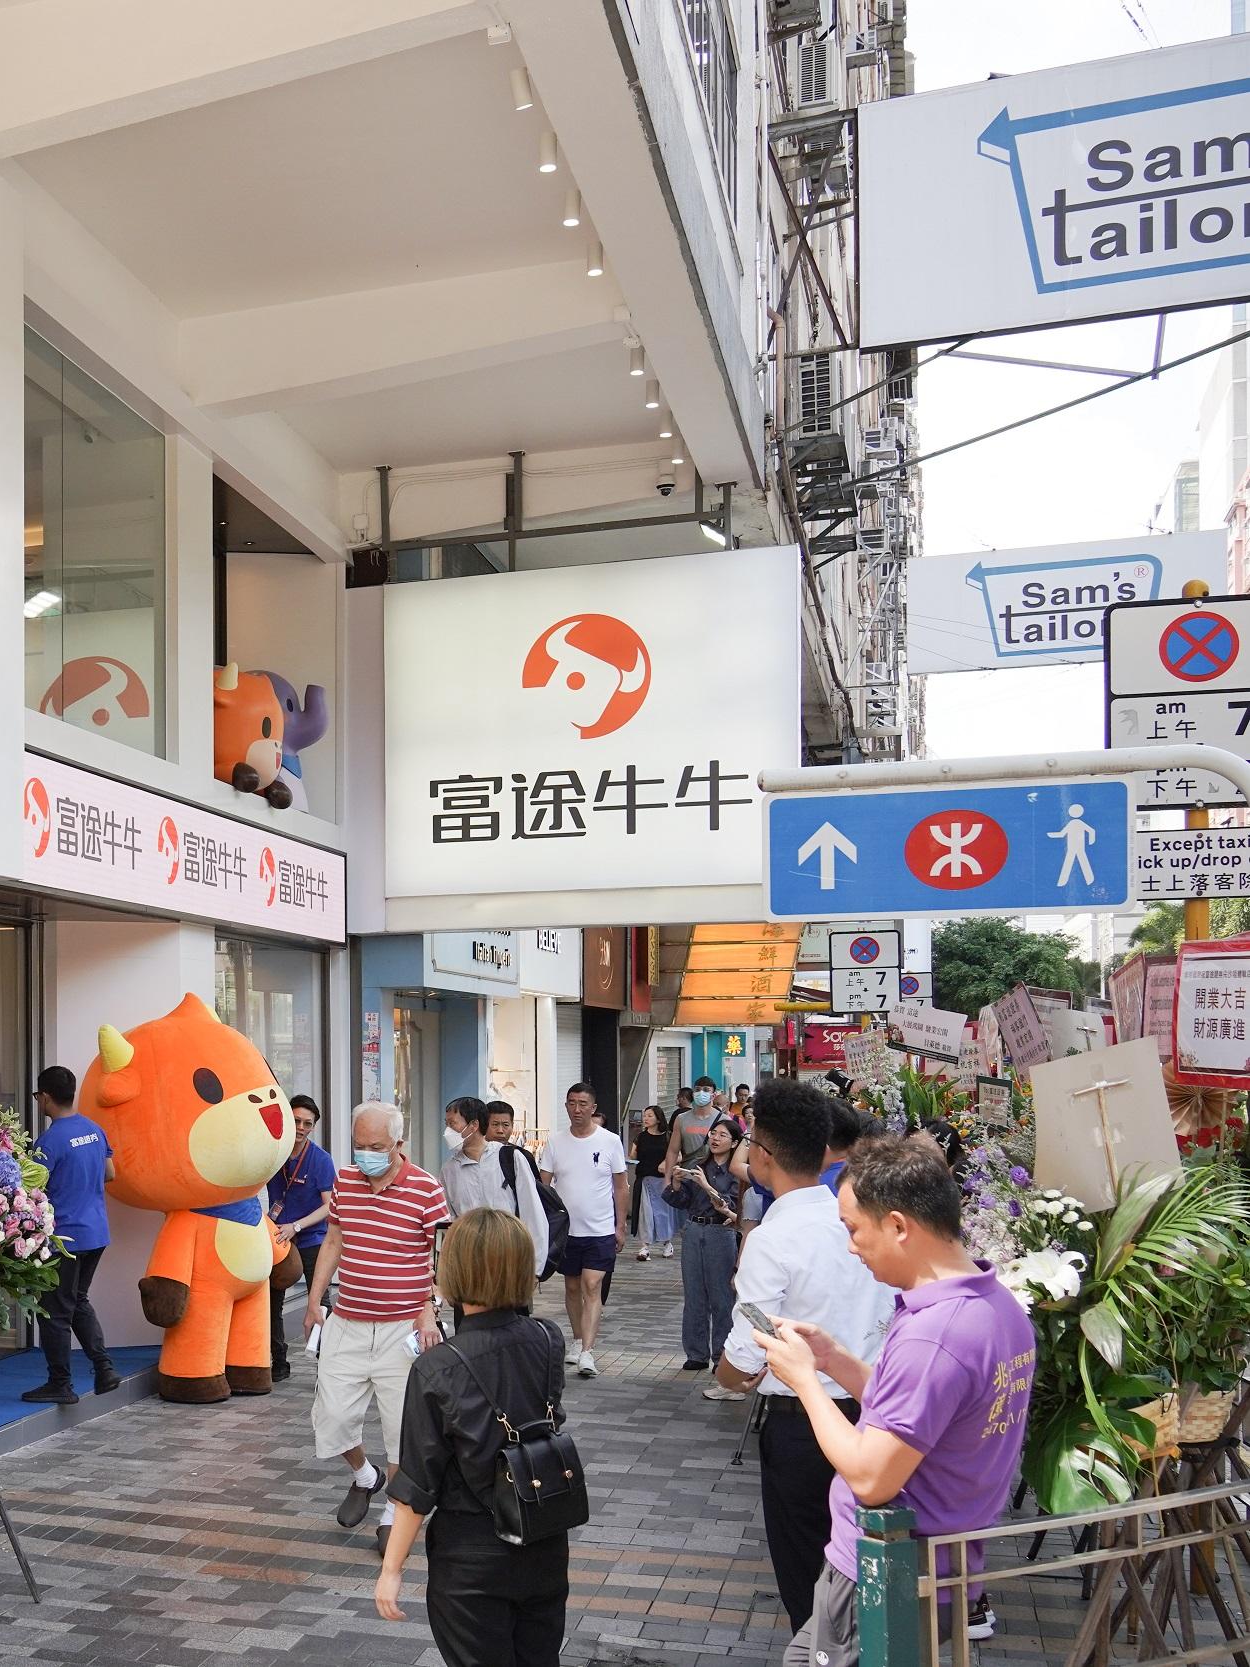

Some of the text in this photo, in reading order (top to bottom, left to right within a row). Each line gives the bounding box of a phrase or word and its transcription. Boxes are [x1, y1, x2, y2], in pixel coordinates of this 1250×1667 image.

[1041, 188, 1250, 267] tailo
[1021, 571, 1136, 609] Sam's
[999, 604, 1105, 645] tailo
[1146, 720, 1197, 740] 上午
[1155, 700, 1250, 736] am 7
[1147, 778, 1198, 798] 下午
[430, 760, 753, 844] 富途牛牛
[56, 796, 143, 870] 富途牛牛
[1150, 836, 1213, 852] Except
[183, 831, 248, 893] 富途牛牛
[1170, 853, 1242, 870] up/drop
[278, 859, 329, 912] 富途牛牛
[845, 978, 865, 987] 上午
[875, 971, 887, 986] 7
[875, 994, 887, 1009] 7
[1194, 986, 1247, 1010] 開業大吉
[1193, 1017, 1246, 1041] 財源廣進
